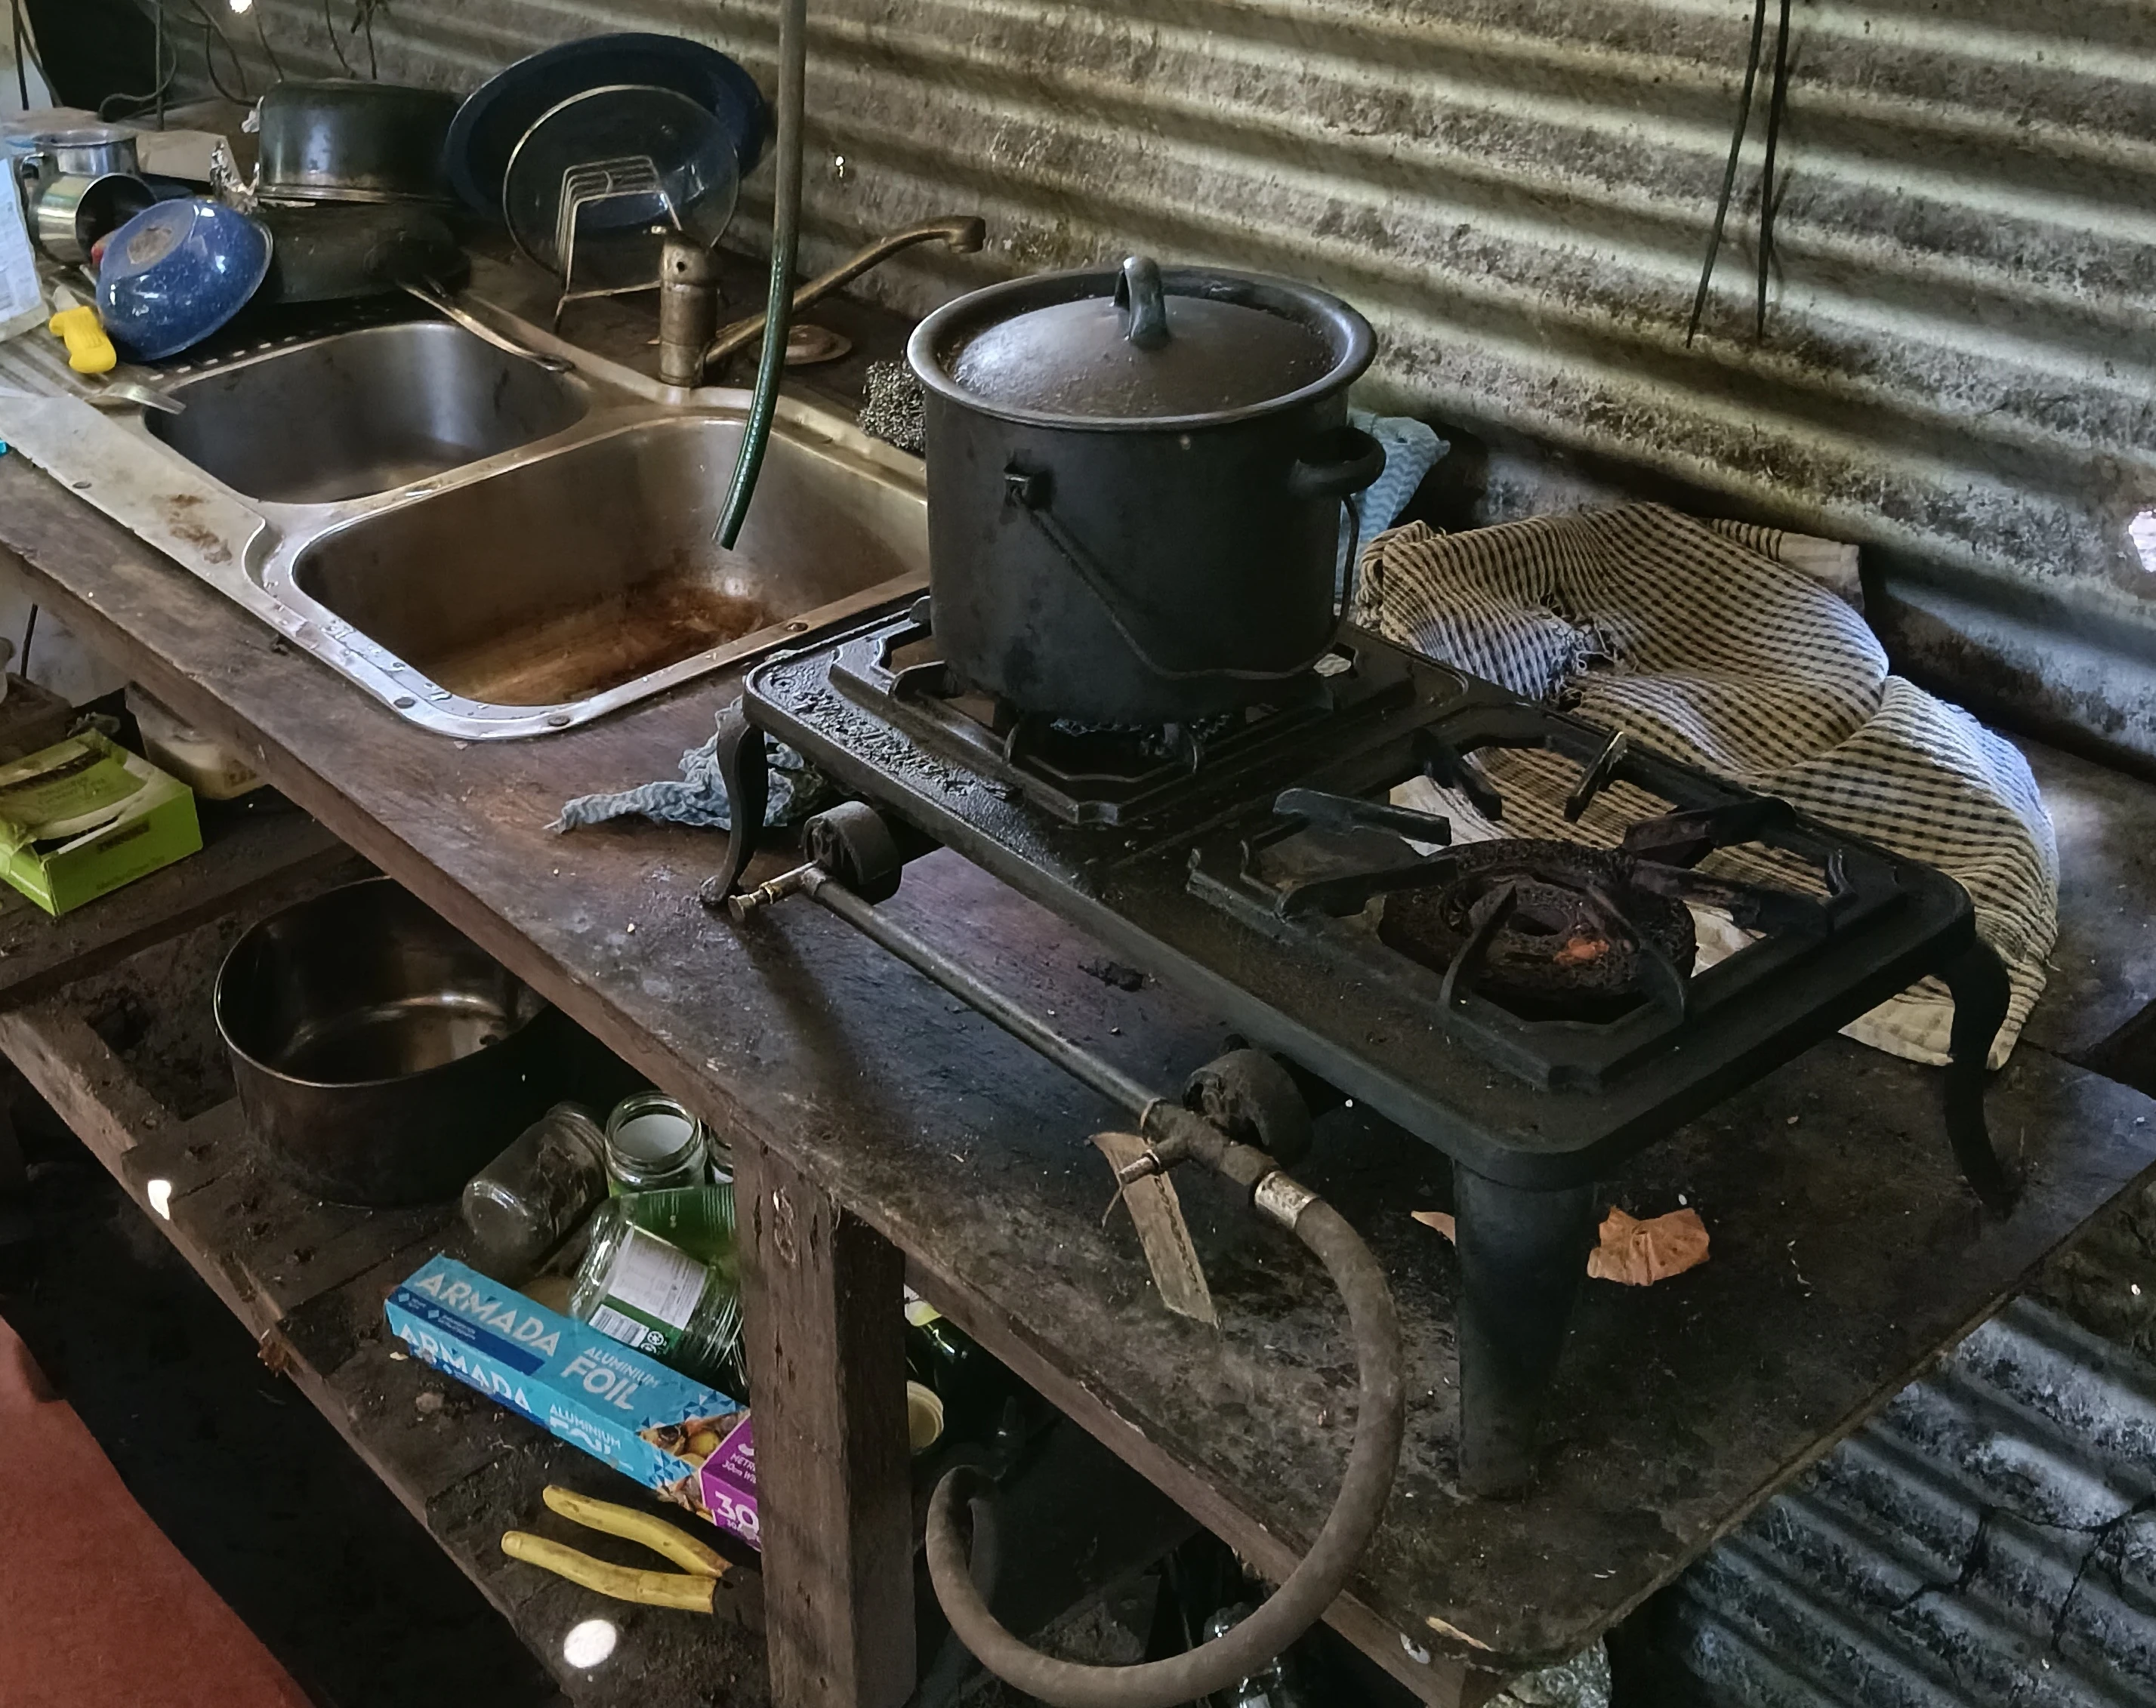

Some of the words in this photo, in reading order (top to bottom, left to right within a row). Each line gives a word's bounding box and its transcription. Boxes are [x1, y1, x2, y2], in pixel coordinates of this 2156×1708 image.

[417, 1272, 560, 1357] ARMADA
[560, 1355, 634, 1410] FOIL
[584, 1346, 660, 1388] ALUMINIUM
[550, 1404, 621, 1450] ALUMINIUM
[715, 1491, 760, 1534] 30
